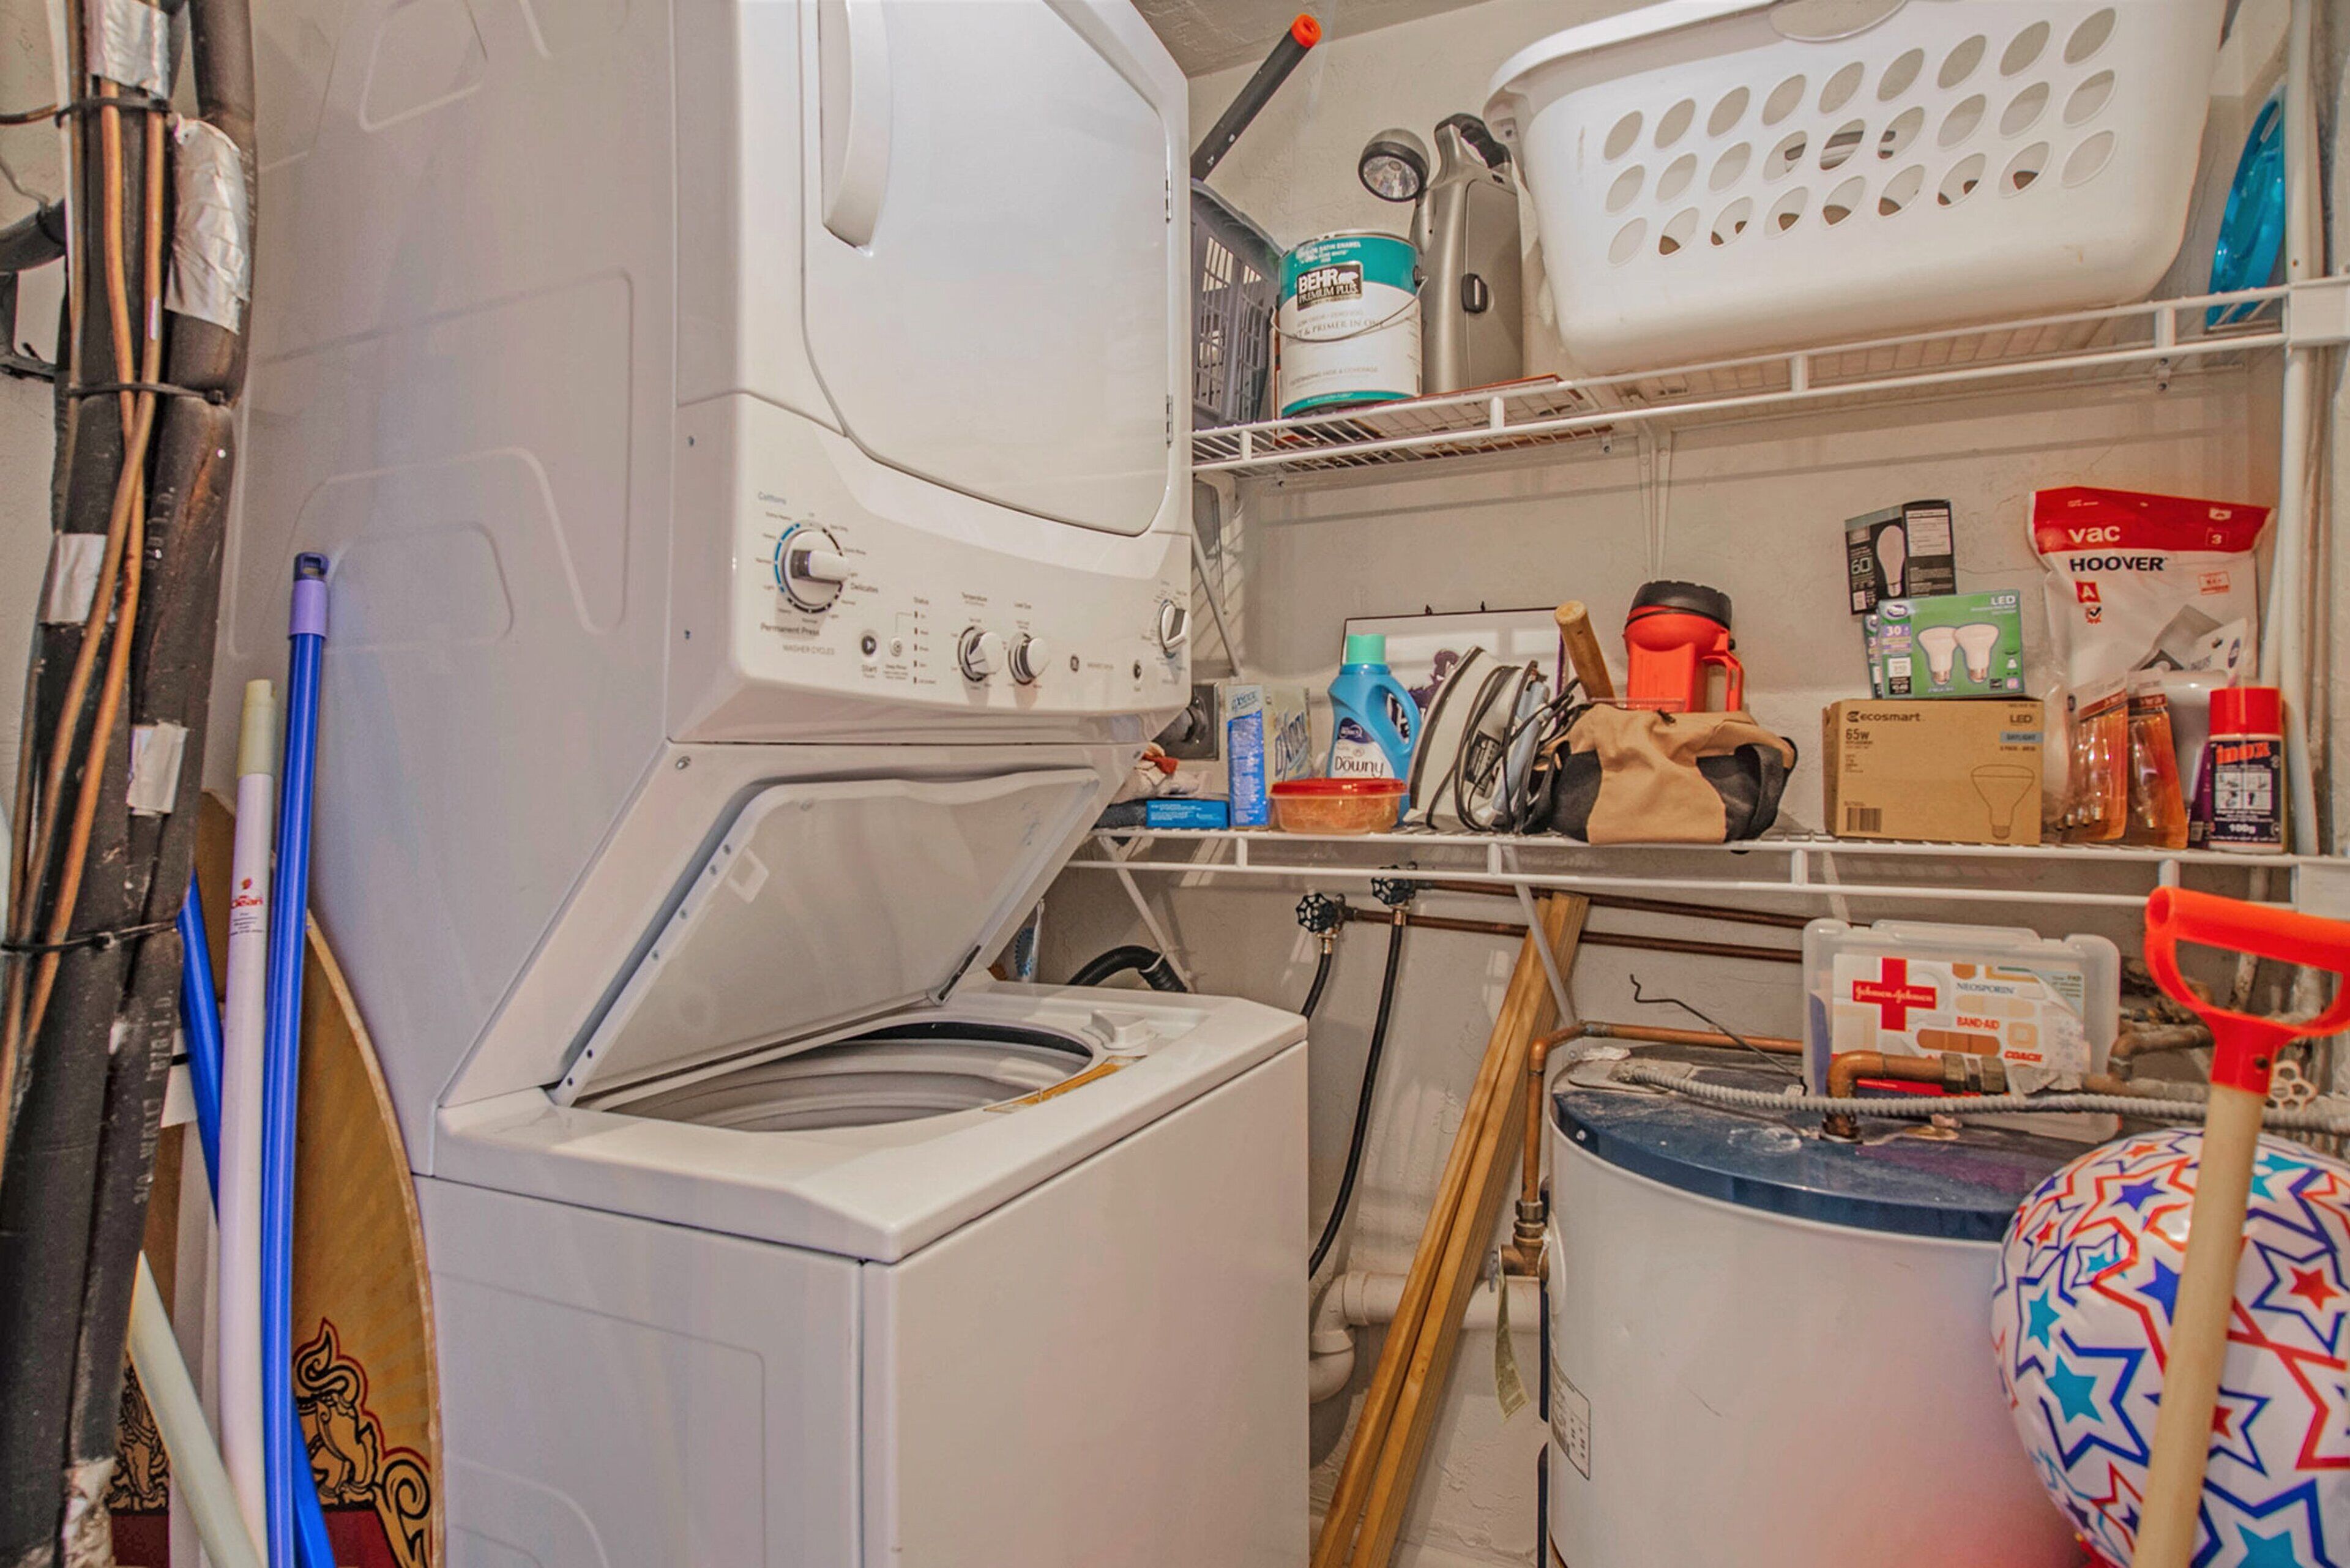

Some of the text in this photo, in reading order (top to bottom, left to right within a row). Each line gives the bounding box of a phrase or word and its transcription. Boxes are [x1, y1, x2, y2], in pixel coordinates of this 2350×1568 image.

[1299, 268, 1338, 294] BEHR
[1299, 287, 1334, 304] PREMIUM
[1337, 282, 1359, 296] PLUS
[1313, 321, 1346, 334] PRIMER
[1349, 319, 1359, 329] IN
[2067, 526, 2121, 544] vac
[2211, 533, 2222, 545] 3
[1850, 556, 1871, 575] 60
[2070, 556, 2165, 572] HOOVER
[2082, 585, 2092, 597] A
[1991, 595, 2016, 606] LED
[802, 626, 820, 636] Press
[1886, 625, 1901, 637] 30
[1860, 712, 1920, 722] ecosmart
[2010, 714, 2033, 724] LED
[1335, 756, 1384, 778] Downy
[1956, 982, 2015, 994] NEOSPORIN
[1956, 1016, 2000, 1031] BAND-AID
[2004, 1050, 2043, 1062] COACH
